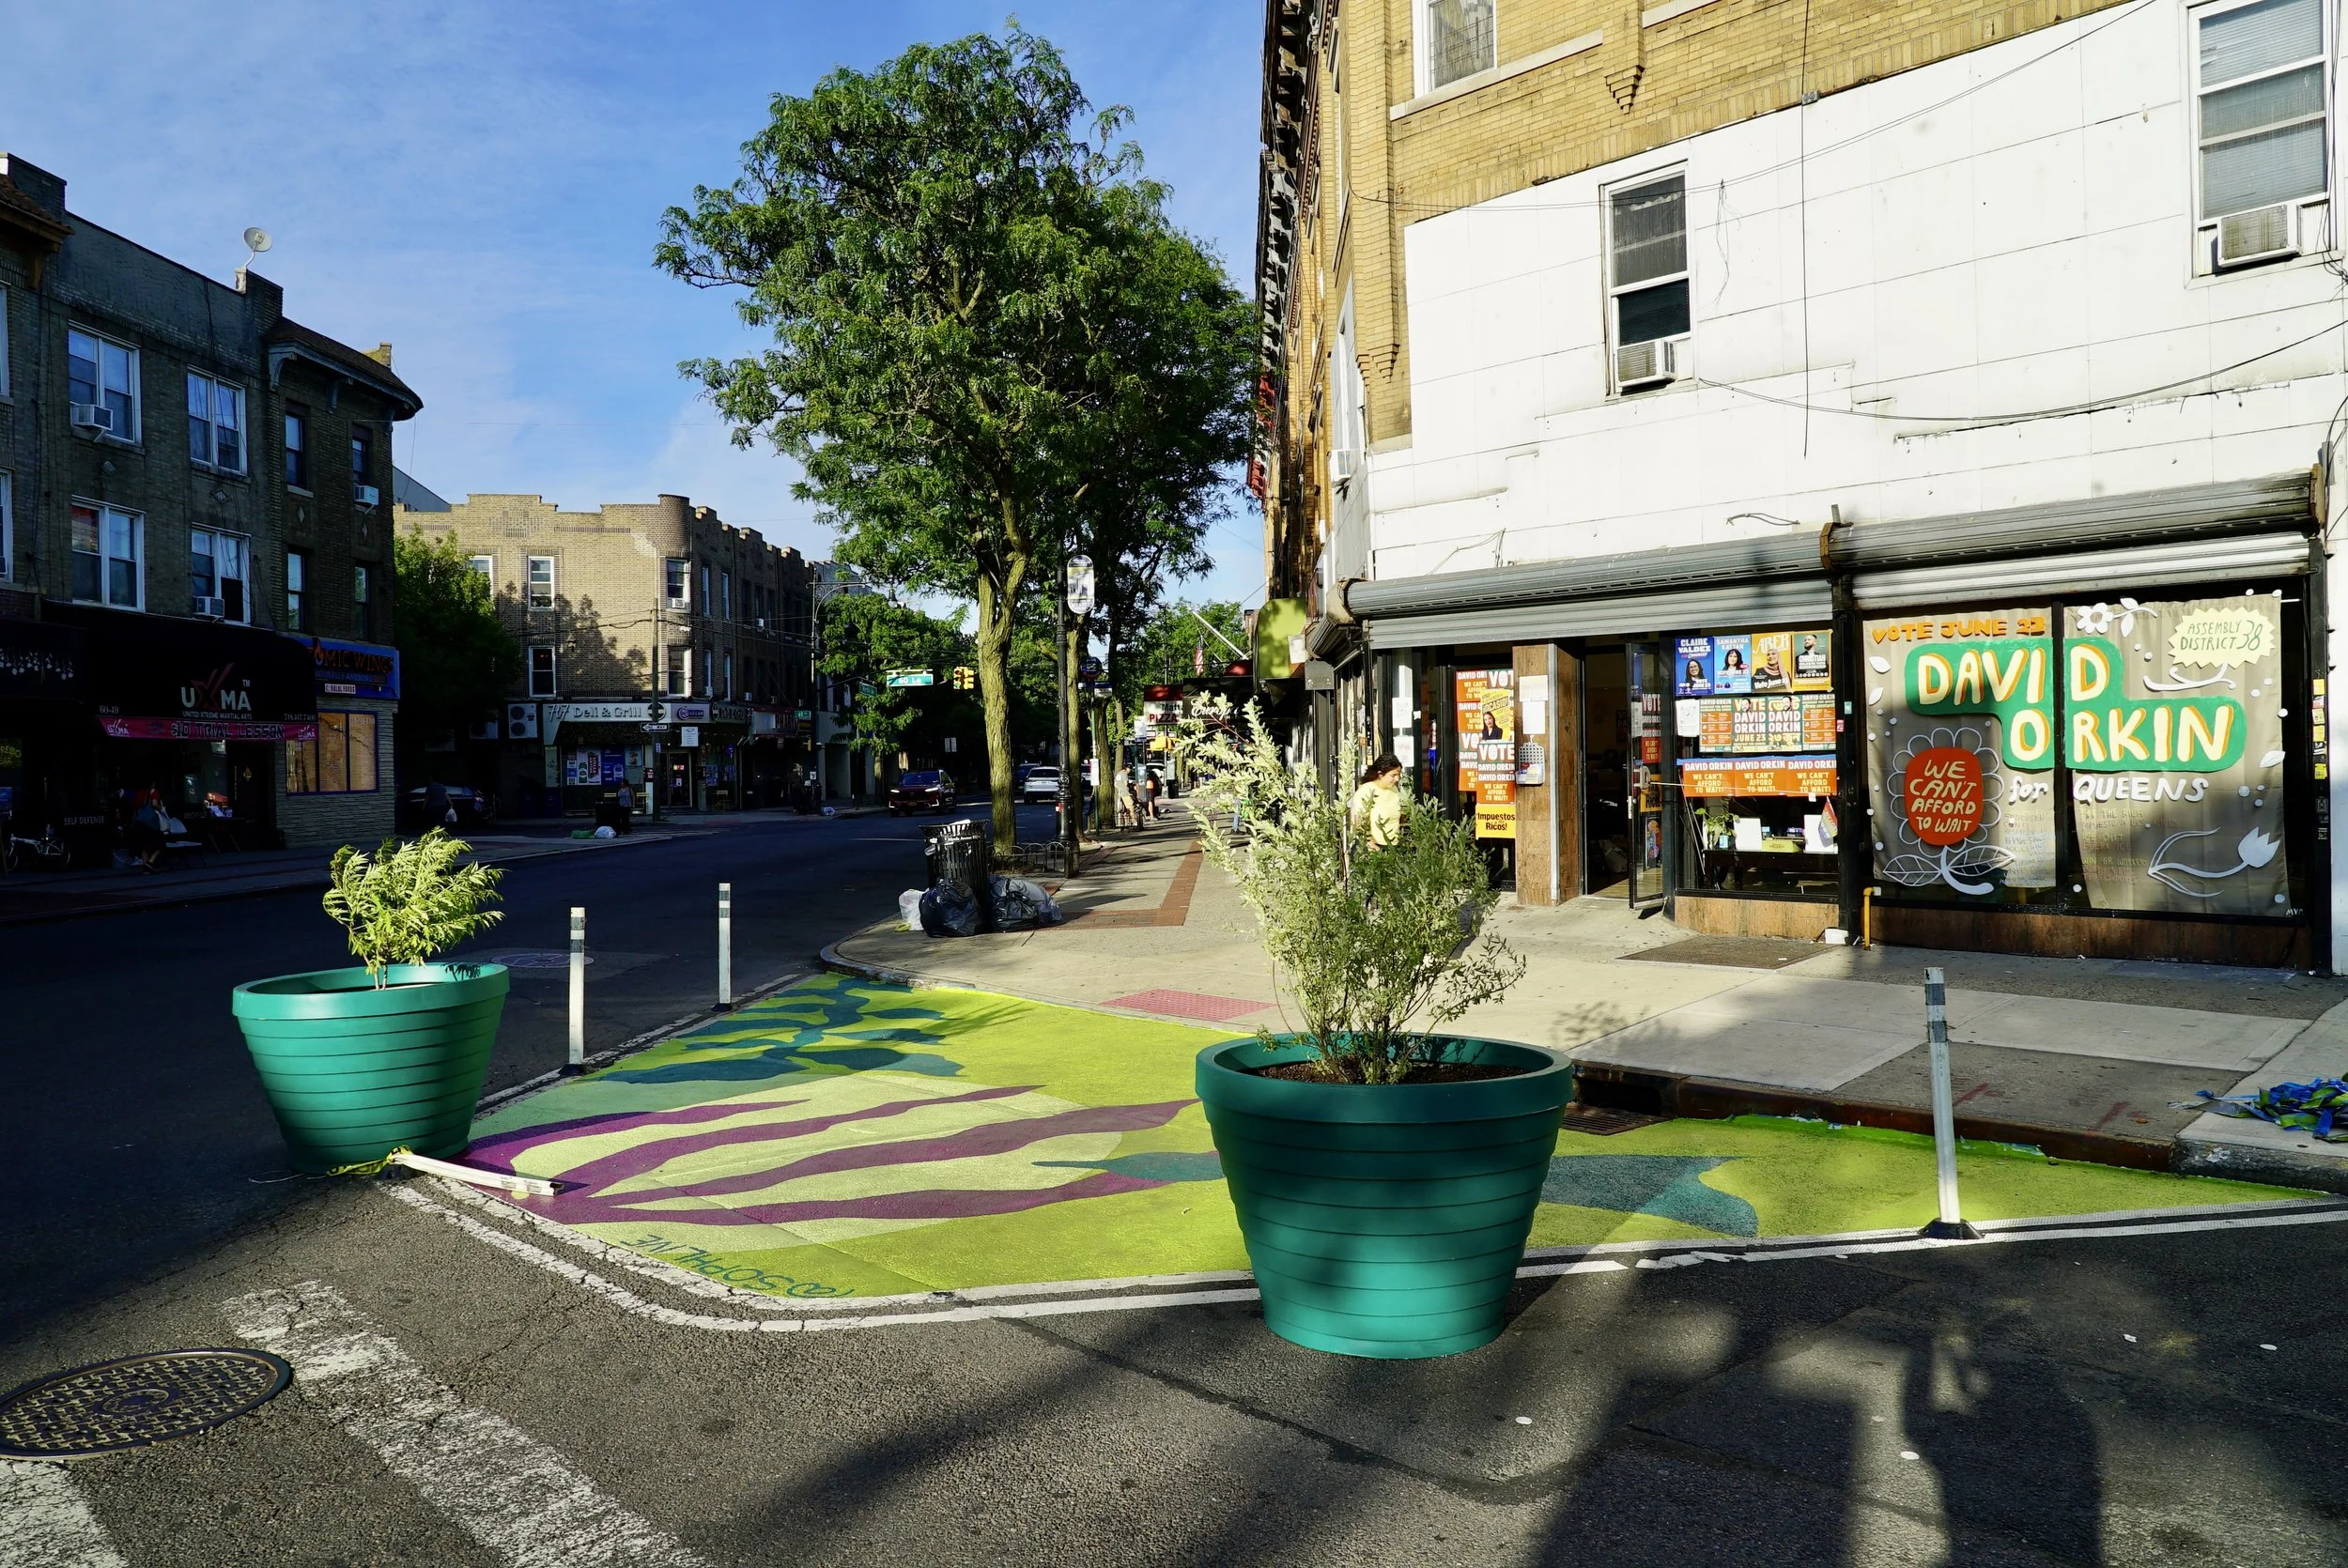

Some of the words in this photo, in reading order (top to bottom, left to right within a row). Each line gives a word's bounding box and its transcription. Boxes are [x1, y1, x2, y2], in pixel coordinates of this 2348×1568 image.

[1872, 622, 1934, 645] VOTE
[1940, 617, 2008, 638] JUNE
[2016, 616, 2046, 637] 23
[2187, 620, 2242, 635] ASSEMBLY
[2180, 637, 2236, 651] DISTRICT
[2236, 620, 2263, 651] 38
[1458, 671, 1476, 680] DAVID
[1918, 644, 2110, 706] DAVID
[99, 705, 119, 715] 60-49
[1733, 698, 1766, 712] VTE
[573, 706, 598, 717] Deli
[614, 706, 641, 718] Grill
[1149, 713, 1178, 723] PIZZA
[1734, 712, 1766, 723] DAVID
[1768, 711, 1801, 722] DAVID
[238, 723, 285, 739] LESSON
[1734, 723, 1766, 733] ORKIN
[1768, 722, 1800, 732] ORKIN
[2010, 704, 2234, 762] ORKIN
[1734, 733, 1755, 743] JUNE
[1755, 733, 1767, 742] 23
[1478, 744, 1515, 761] VOTE
[1478, 763, 1496, 772] DAVID
[1923, 759, 1967, 779] WE
[1909, 778, 1977, 799] CAN'T
[2009, 776, 2049, 805] for
[2072, 776, 2209, 804] QUEENS
[1911, 798, 1976, 815] AFFORD
[63, 816, 78, 826] SELF
[79, 814, 106, 825] DEFENSE
[1477, 812, 1516, 822] Impuestos
[1486, 822, 1507, 831] Ricos!
[1916, 817, 1932, 830] TO
[1935, 818, 1972, 833] WAIT
